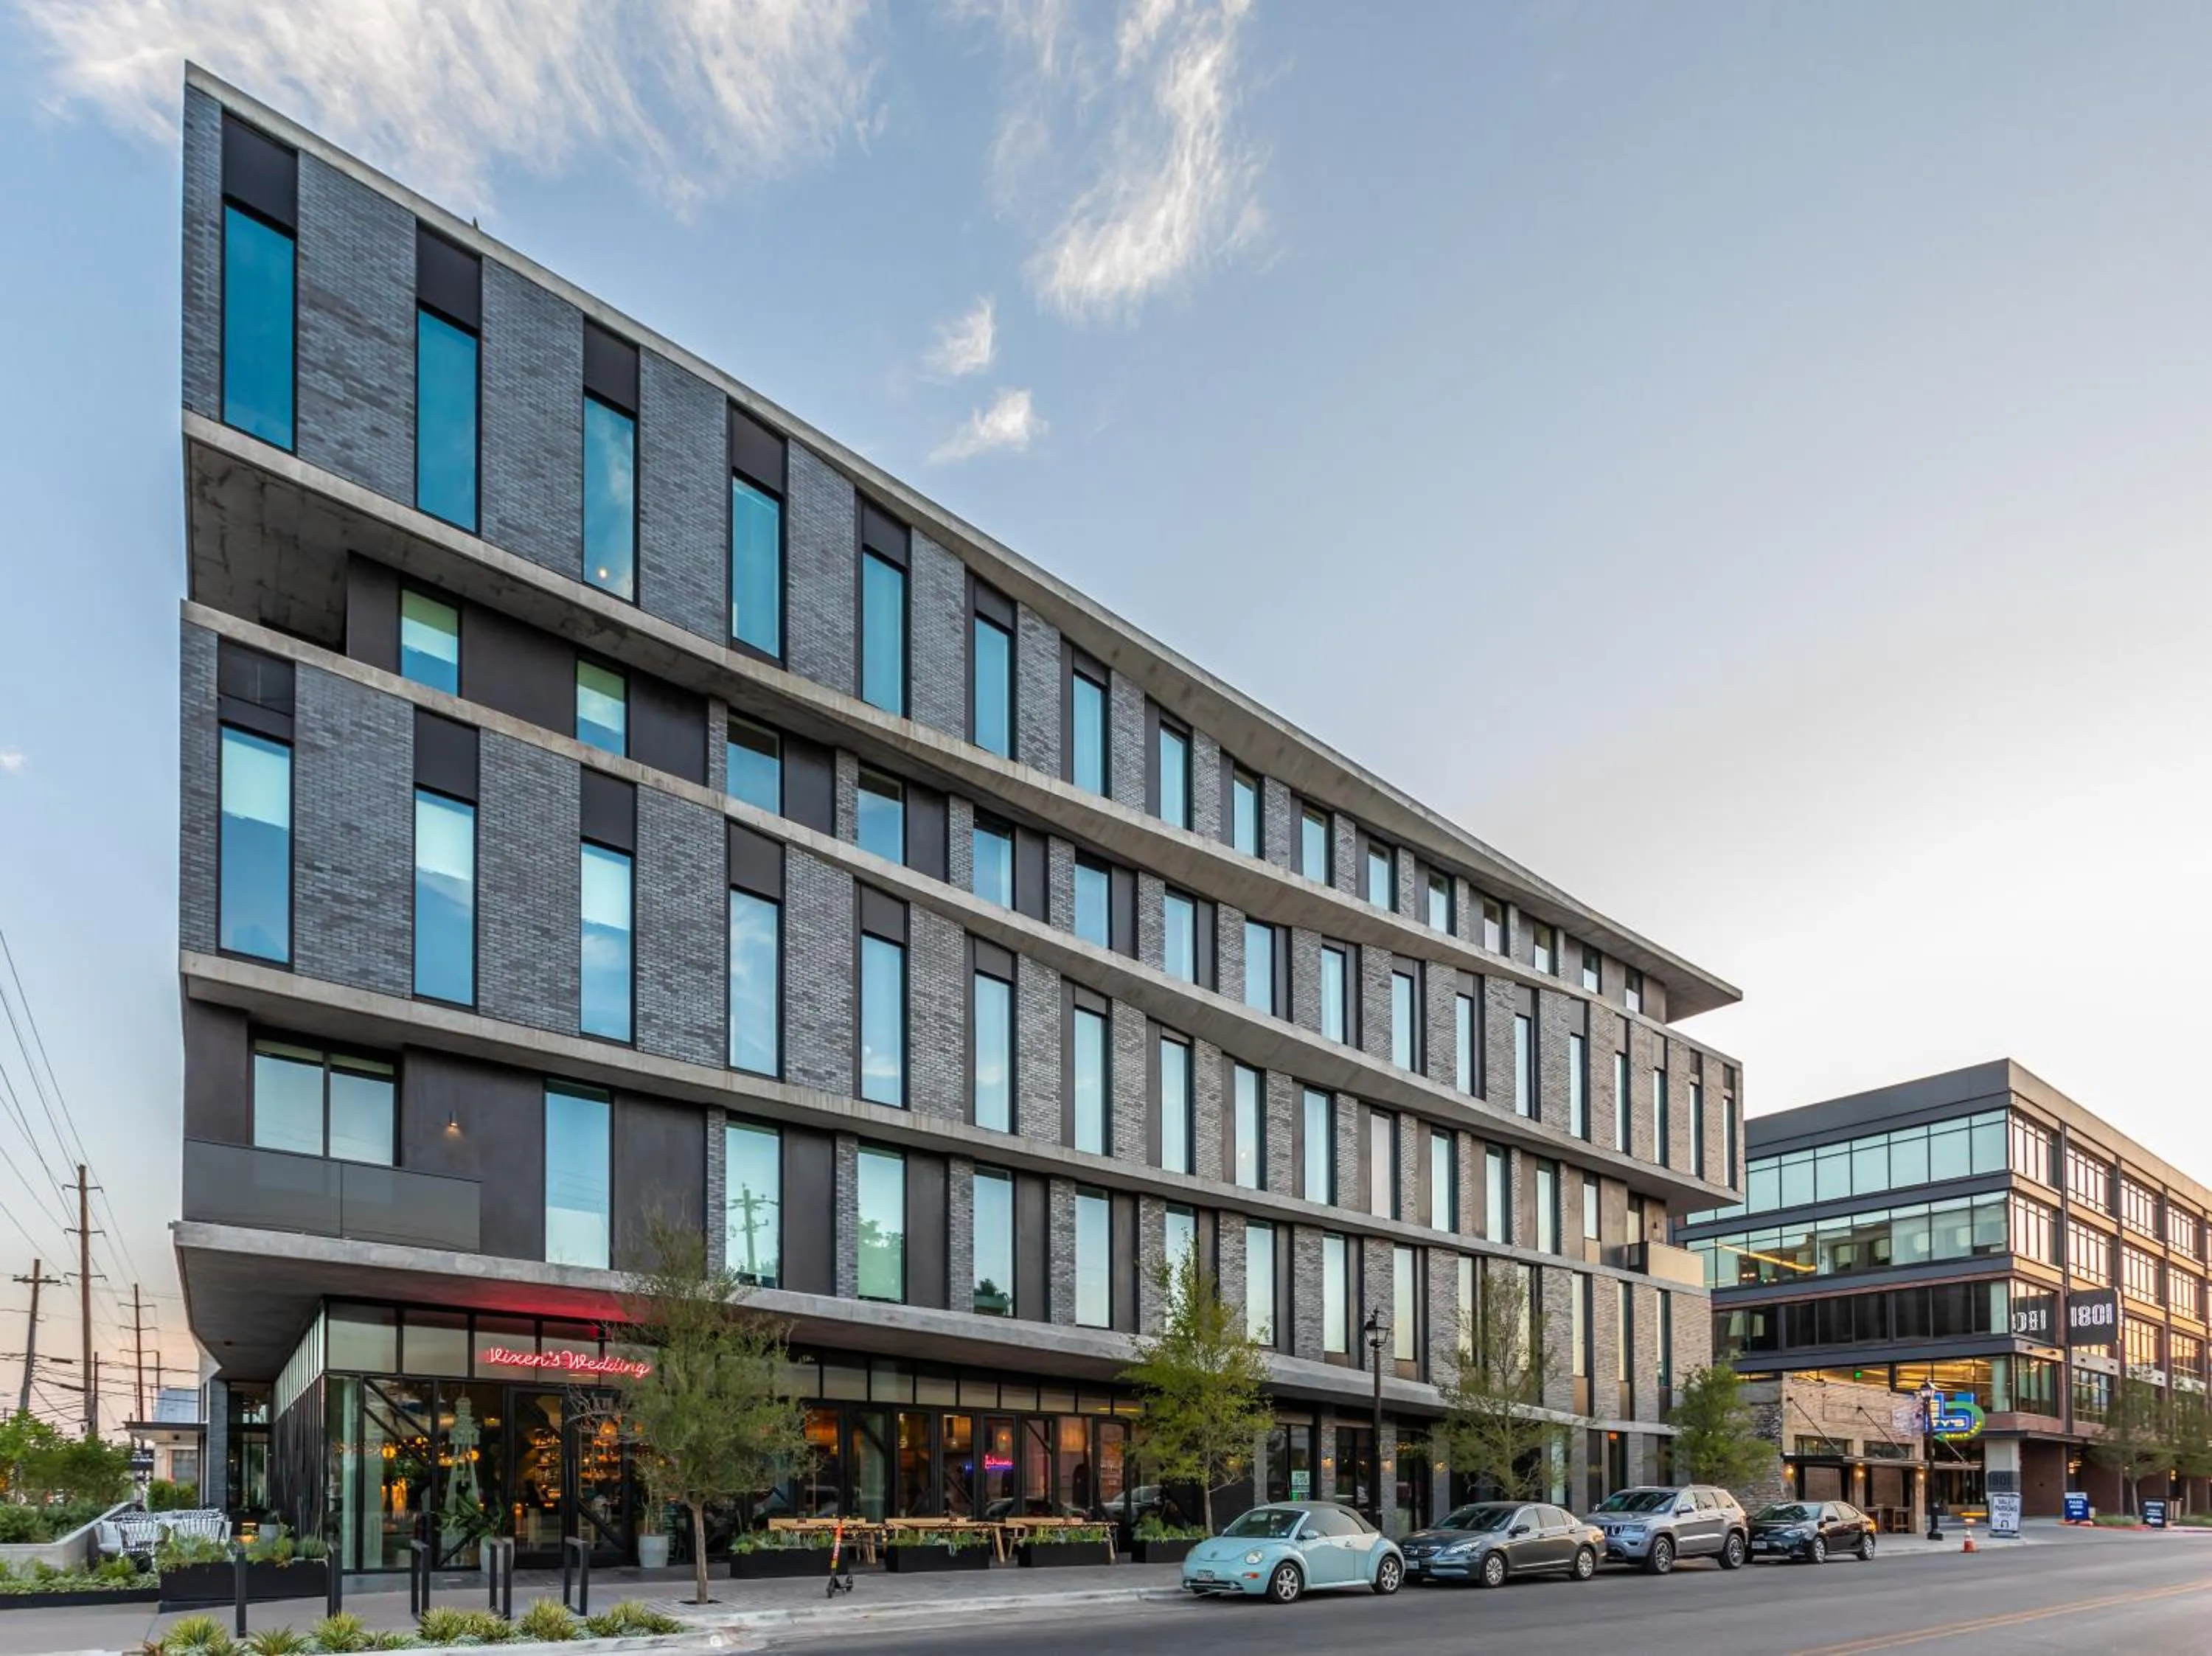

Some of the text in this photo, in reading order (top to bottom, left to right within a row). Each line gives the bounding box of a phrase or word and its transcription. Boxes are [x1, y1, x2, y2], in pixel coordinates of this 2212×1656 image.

[2070, 1303, 2113, 1328] 1801
[489, 1346, 650, 1377] Vixen's Wedding
